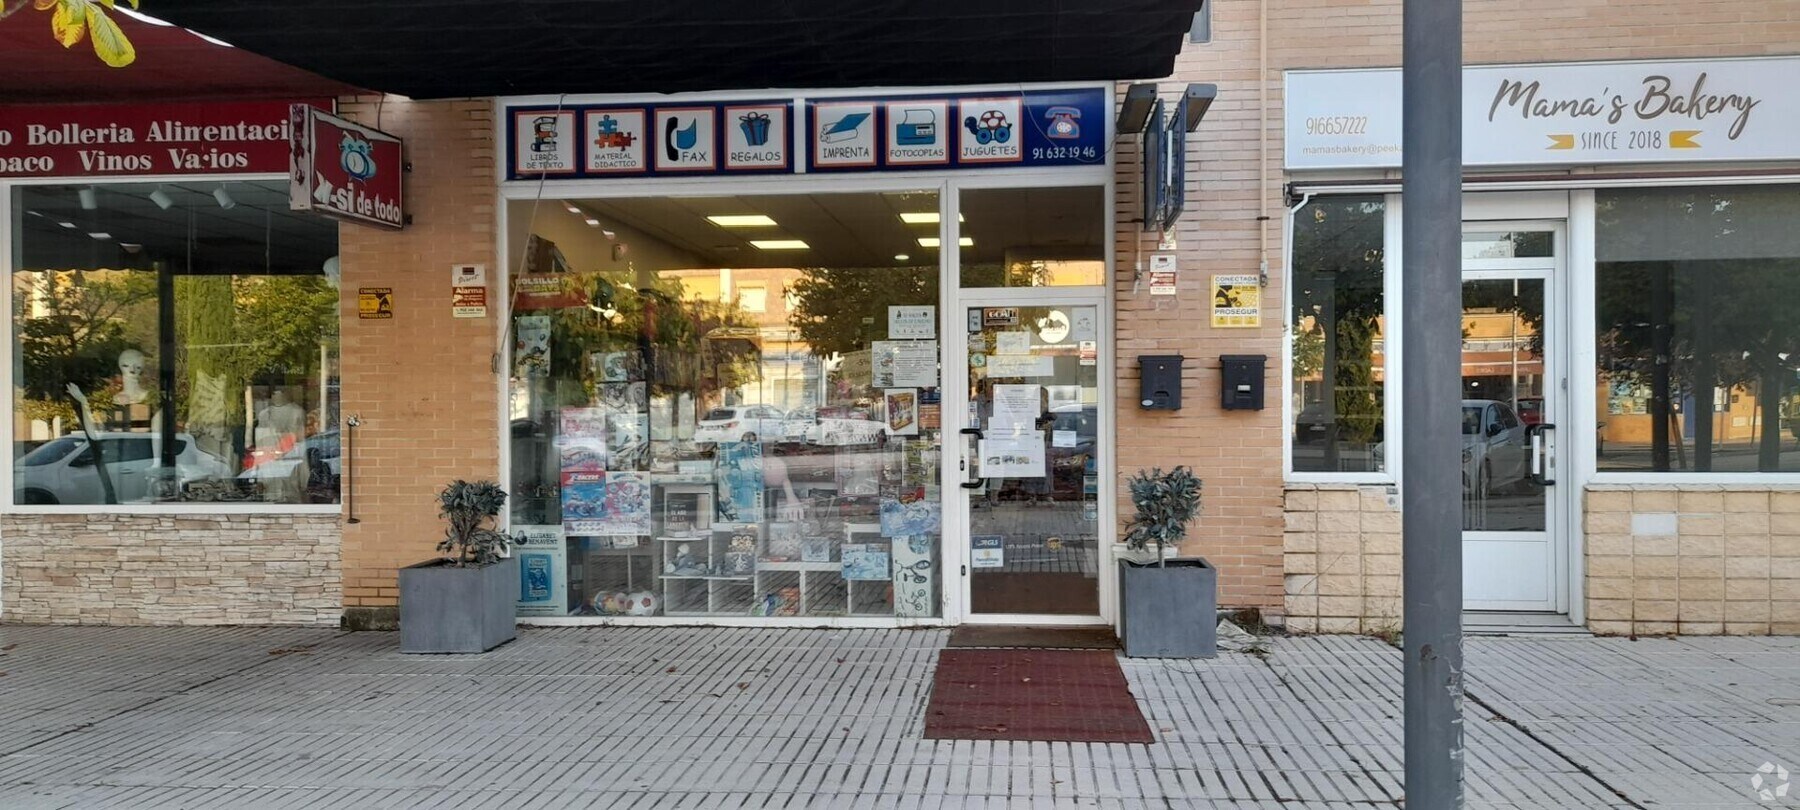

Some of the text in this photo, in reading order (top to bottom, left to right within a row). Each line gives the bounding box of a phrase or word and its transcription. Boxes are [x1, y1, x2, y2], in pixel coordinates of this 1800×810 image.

[1488, 72, 1761, 140] Mama's Bakery
[1305, 116, 1367, 135] 916657222
[26, 122, 135, 145] Bolleria
[1581, 130, 1662, 149] SINCE 2018
[823, 147, 870, 158] IMPRENTA
[890, 148, 944, 157] FOTOCOPIAS
[962, 145, 1017, 156] JUGUETES
[1033, 146, 1095, 160] 91 632 19 46
[1302, 144, 1401, 155] mamasbakery@peek
[78, 150, 152, 171] Vinos
[682, 151, 707, 162] FAX
[730, 151, 781, 162] REGALOS
[594, 160, 636, 168] DIDACTICO
[357, 190, 372, 216] de
[374, 193, 400, 222] todo
